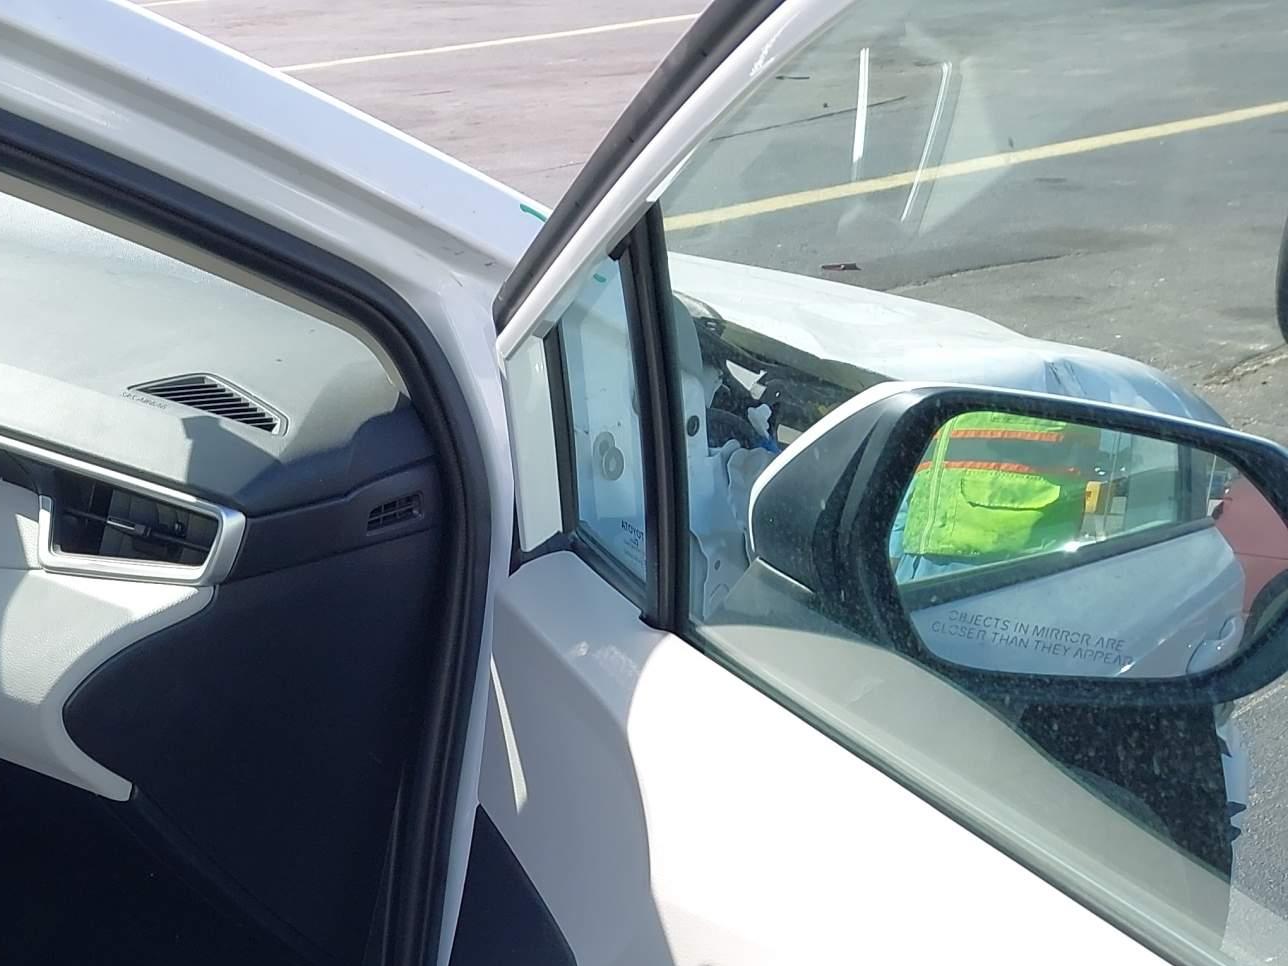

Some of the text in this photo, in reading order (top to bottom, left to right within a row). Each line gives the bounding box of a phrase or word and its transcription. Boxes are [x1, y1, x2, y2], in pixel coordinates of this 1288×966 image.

[931, 620, 987, 640] CLOSER
[991, 631, 1030, 649] THAN
[1033, 639, 1070, 657] THEY
[948, 609, 1125, 652] OBJECTS IN MIRROR ARE
